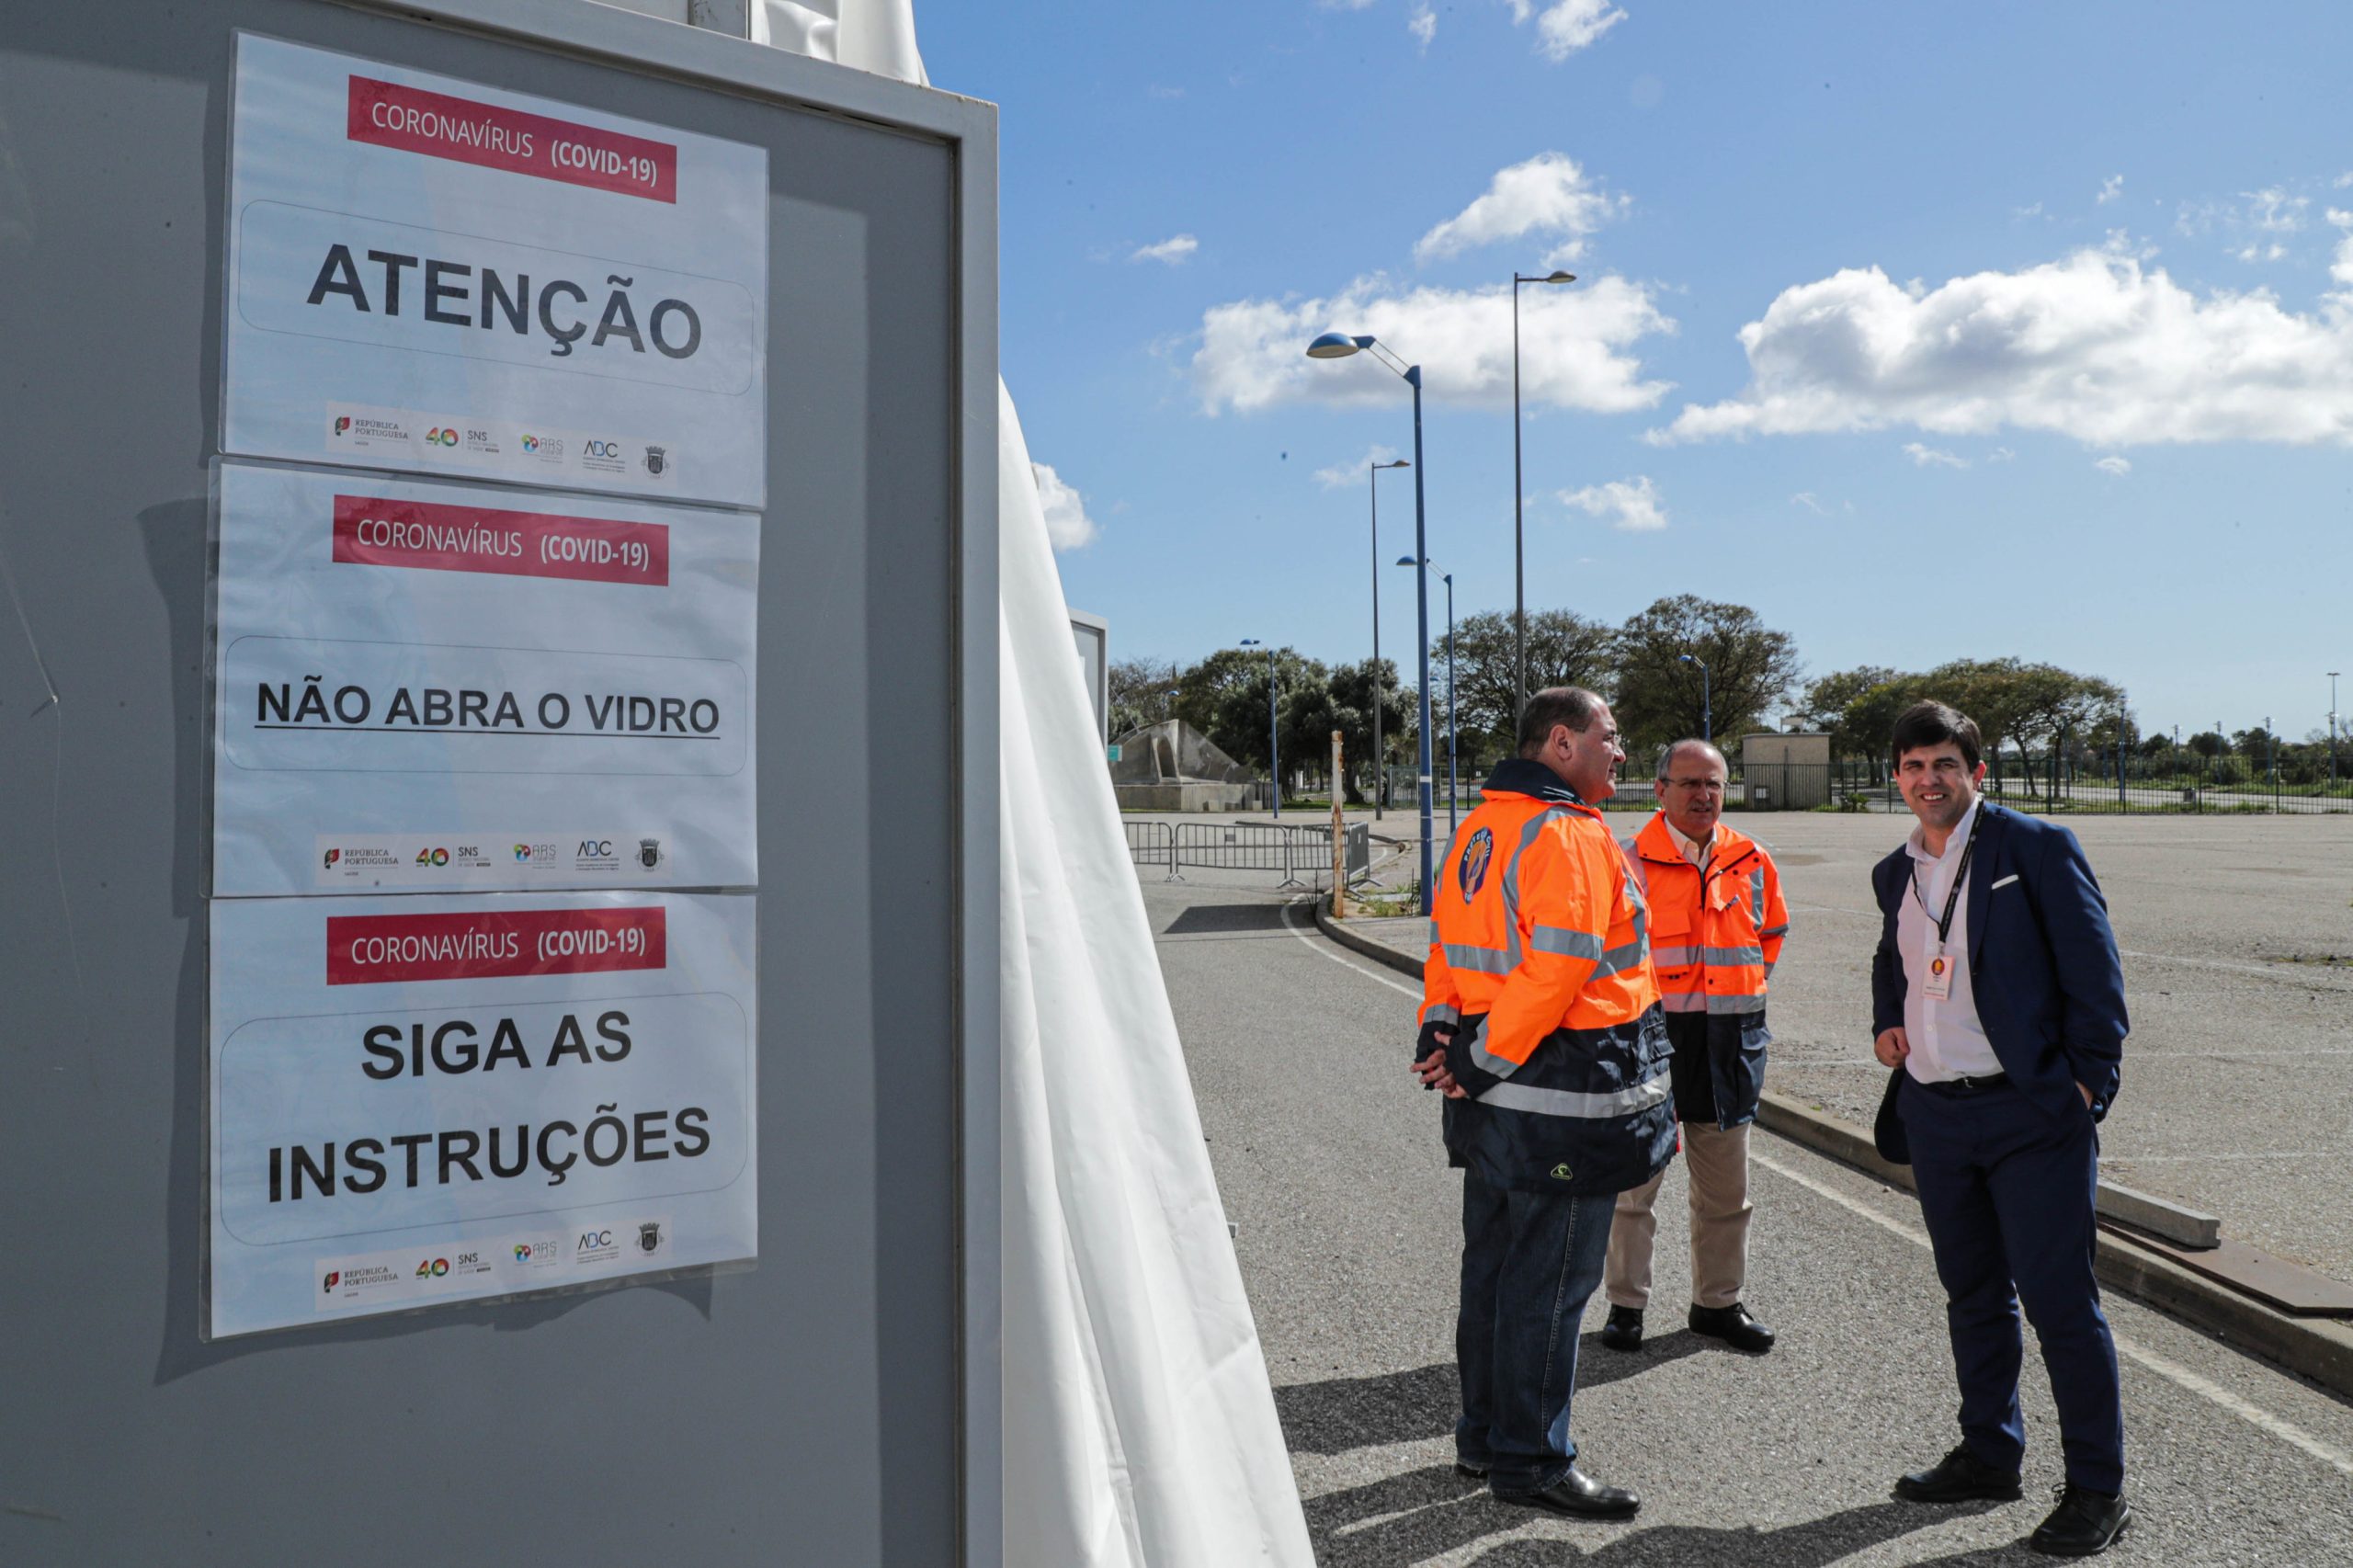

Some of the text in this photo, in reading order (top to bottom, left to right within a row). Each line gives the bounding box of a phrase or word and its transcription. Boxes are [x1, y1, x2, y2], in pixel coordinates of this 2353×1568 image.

[371, 101, 658, 187] CORONAVÍRUS (COVID-19)
[306, 243, 701, 358] ATENÇÃO
[355, 418, 399, 431] REPÚBLICA
[355, 427, 409, 441] PORTUGUESA
[467, 429, 488, 442] SNS
[358, 518, 649, 572] CORONAVÍRUS (COVID-19)
[257, 675, 720, 733] NÃO ABRA O VIDRO
[344, 847, 390, 858] REPÚBLICA
[458, 846, 479, 858] SNS
[344, 857, 399, 866] PORTUGUESA
[351, 926, 646, 965] CORONAVÍRUS (COVID-19)
[361, 1010, 631, 1081] SIGA AS
[268, 1102, 710, 1203] INSTRUÇÕES
[458, 1251, 479, 1265] SNS
[344, 1265, 390, 1278] REPÚBLICA
[344, 1272, 399, 1287] PORTUGUESA
